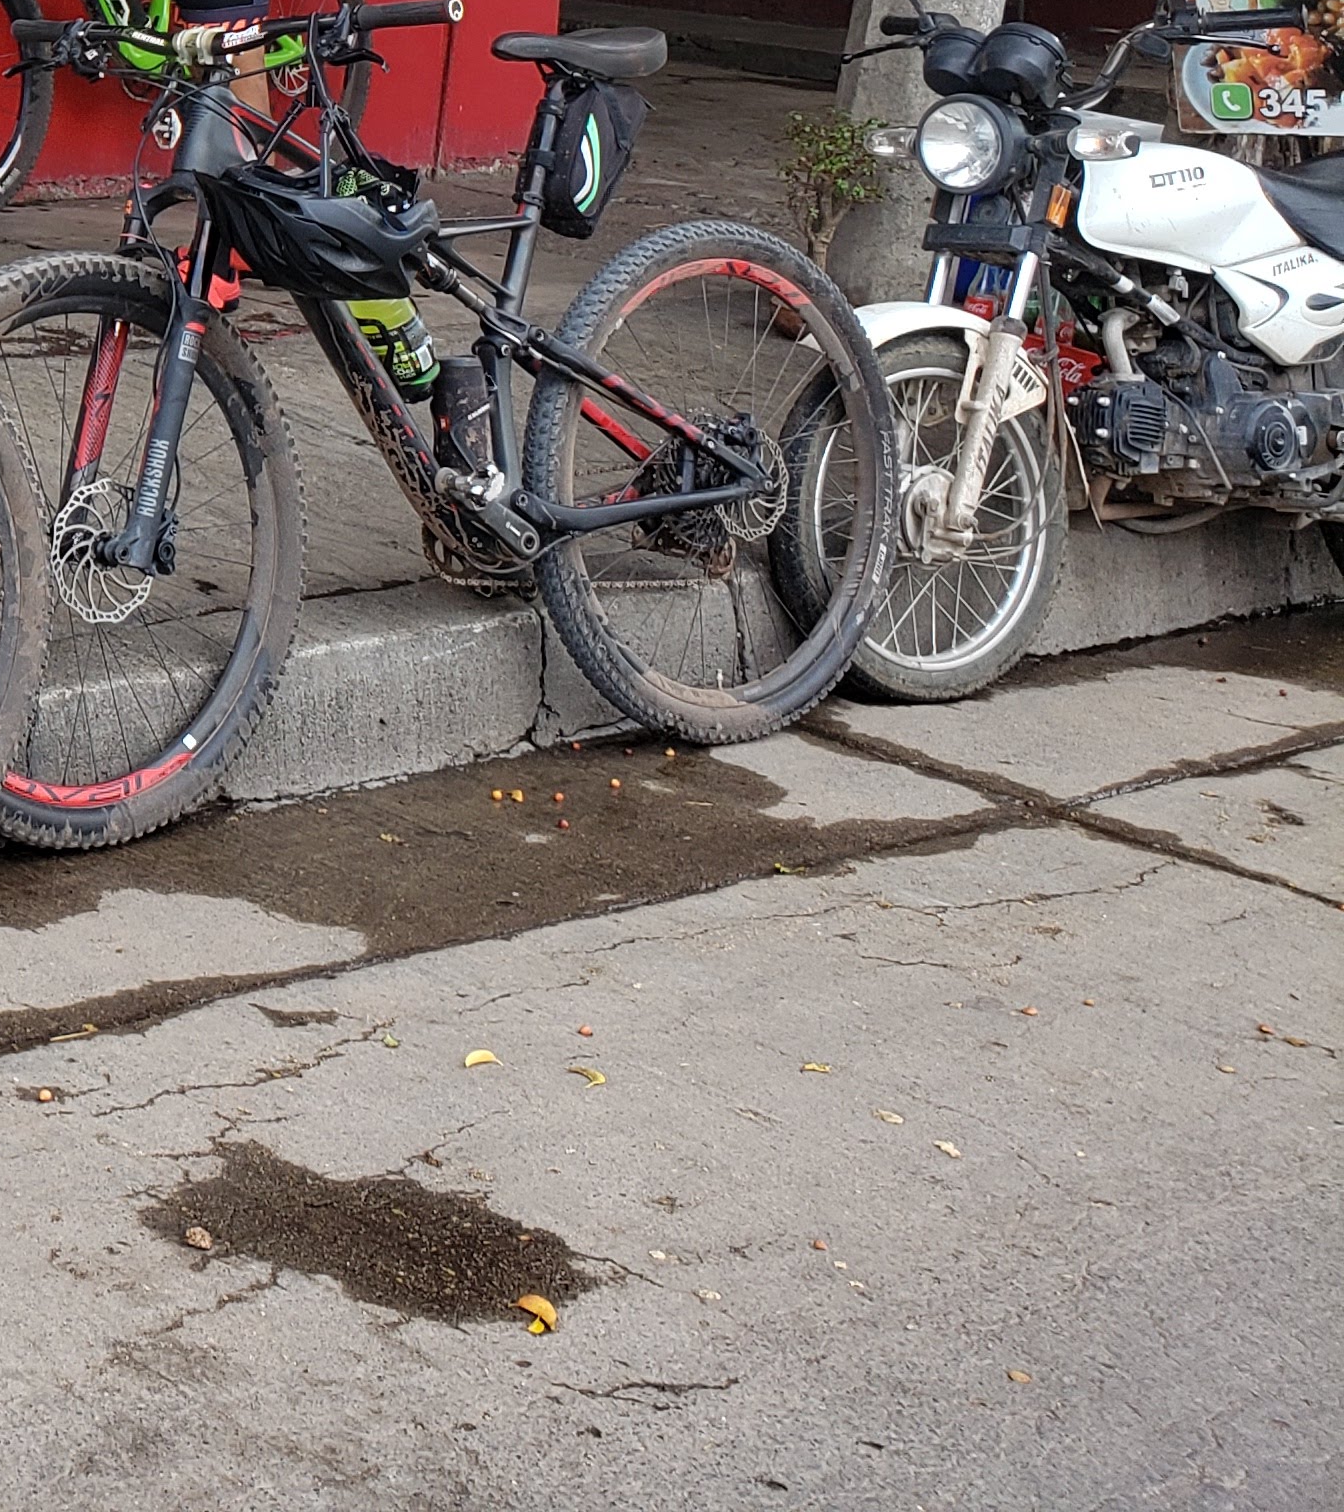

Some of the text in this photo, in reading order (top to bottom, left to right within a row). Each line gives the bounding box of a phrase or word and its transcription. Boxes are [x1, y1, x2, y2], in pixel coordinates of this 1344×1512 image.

[1257, 87, 1327, 119] 345
[1149, 166, 1205, 188] DT110
[1272, 253, 1315, 277] ITALIKA
[135, 438, 170, 519] ROCKSHOX
[880, 429, 896, 543] FAST TRAK
